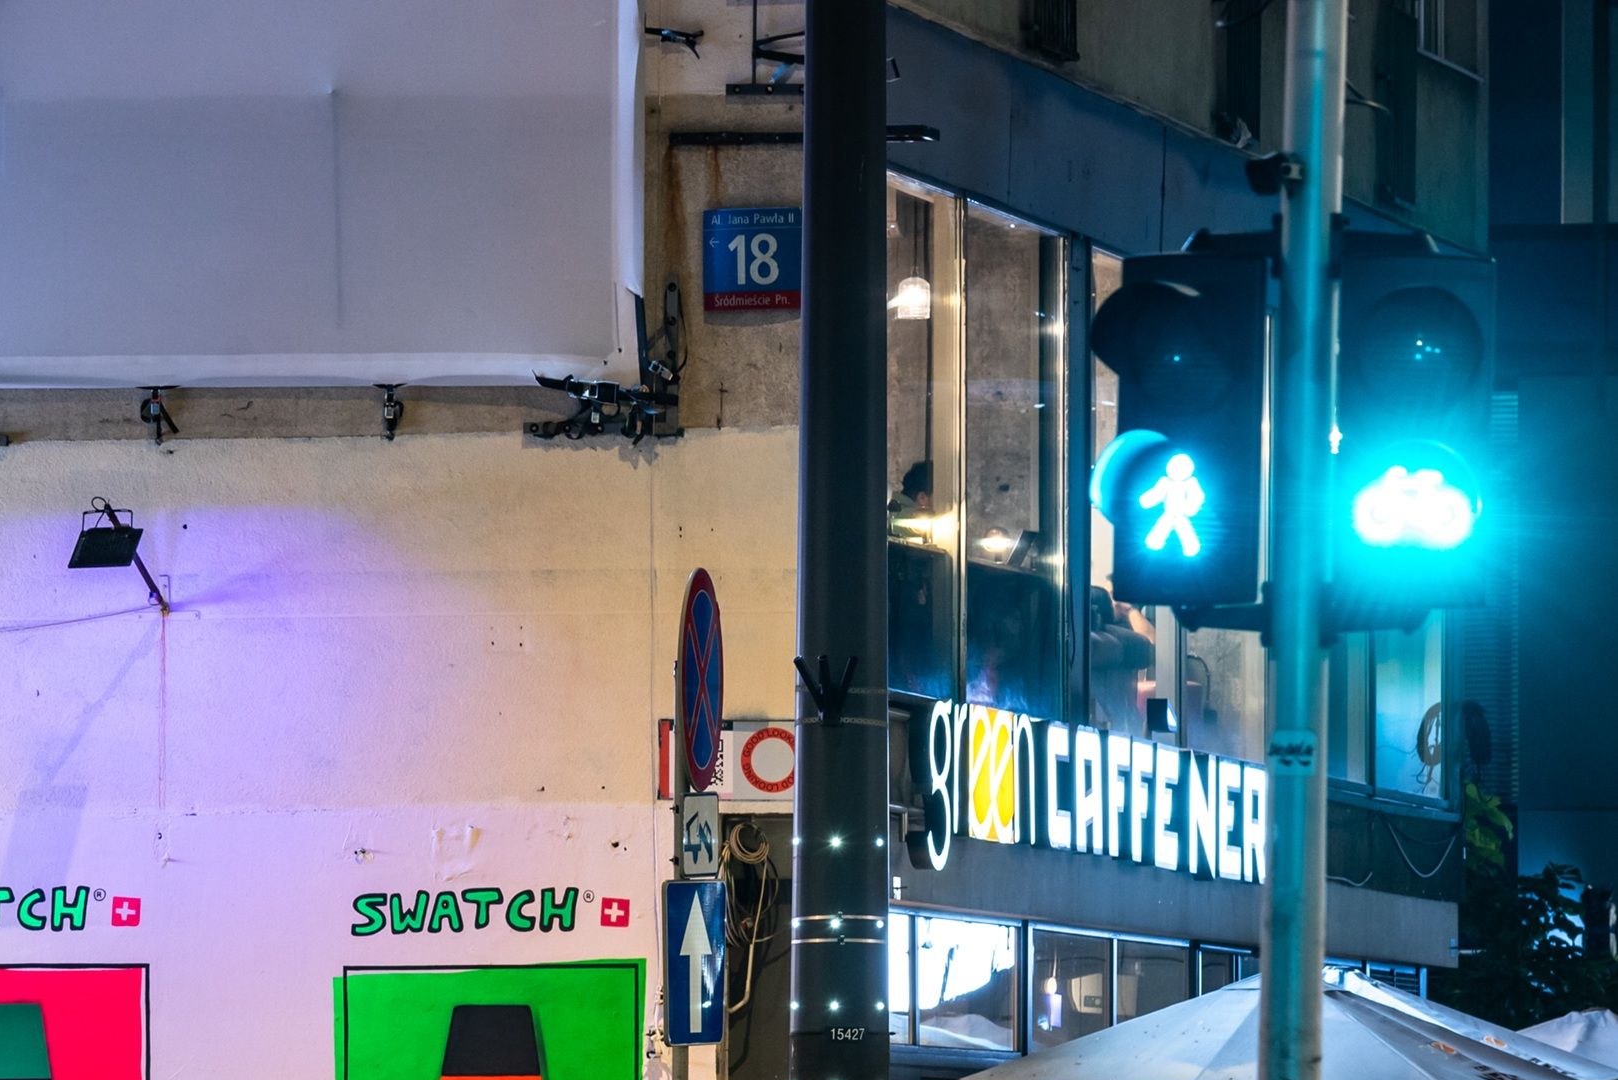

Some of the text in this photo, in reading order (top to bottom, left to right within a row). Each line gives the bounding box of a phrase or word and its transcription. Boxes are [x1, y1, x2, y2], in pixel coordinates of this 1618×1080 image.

[728, 215, 749, 225] Jana
[753, 213, 784, 224] Pawła
[788, 213, 795, 224] II
[728, 233, 779, 285] 18
[714, 294, 791, 307] Śródmieście Pn.
[1189, 749, 1268, 885] NER
[831, 1028, 865, 1040] 15427
